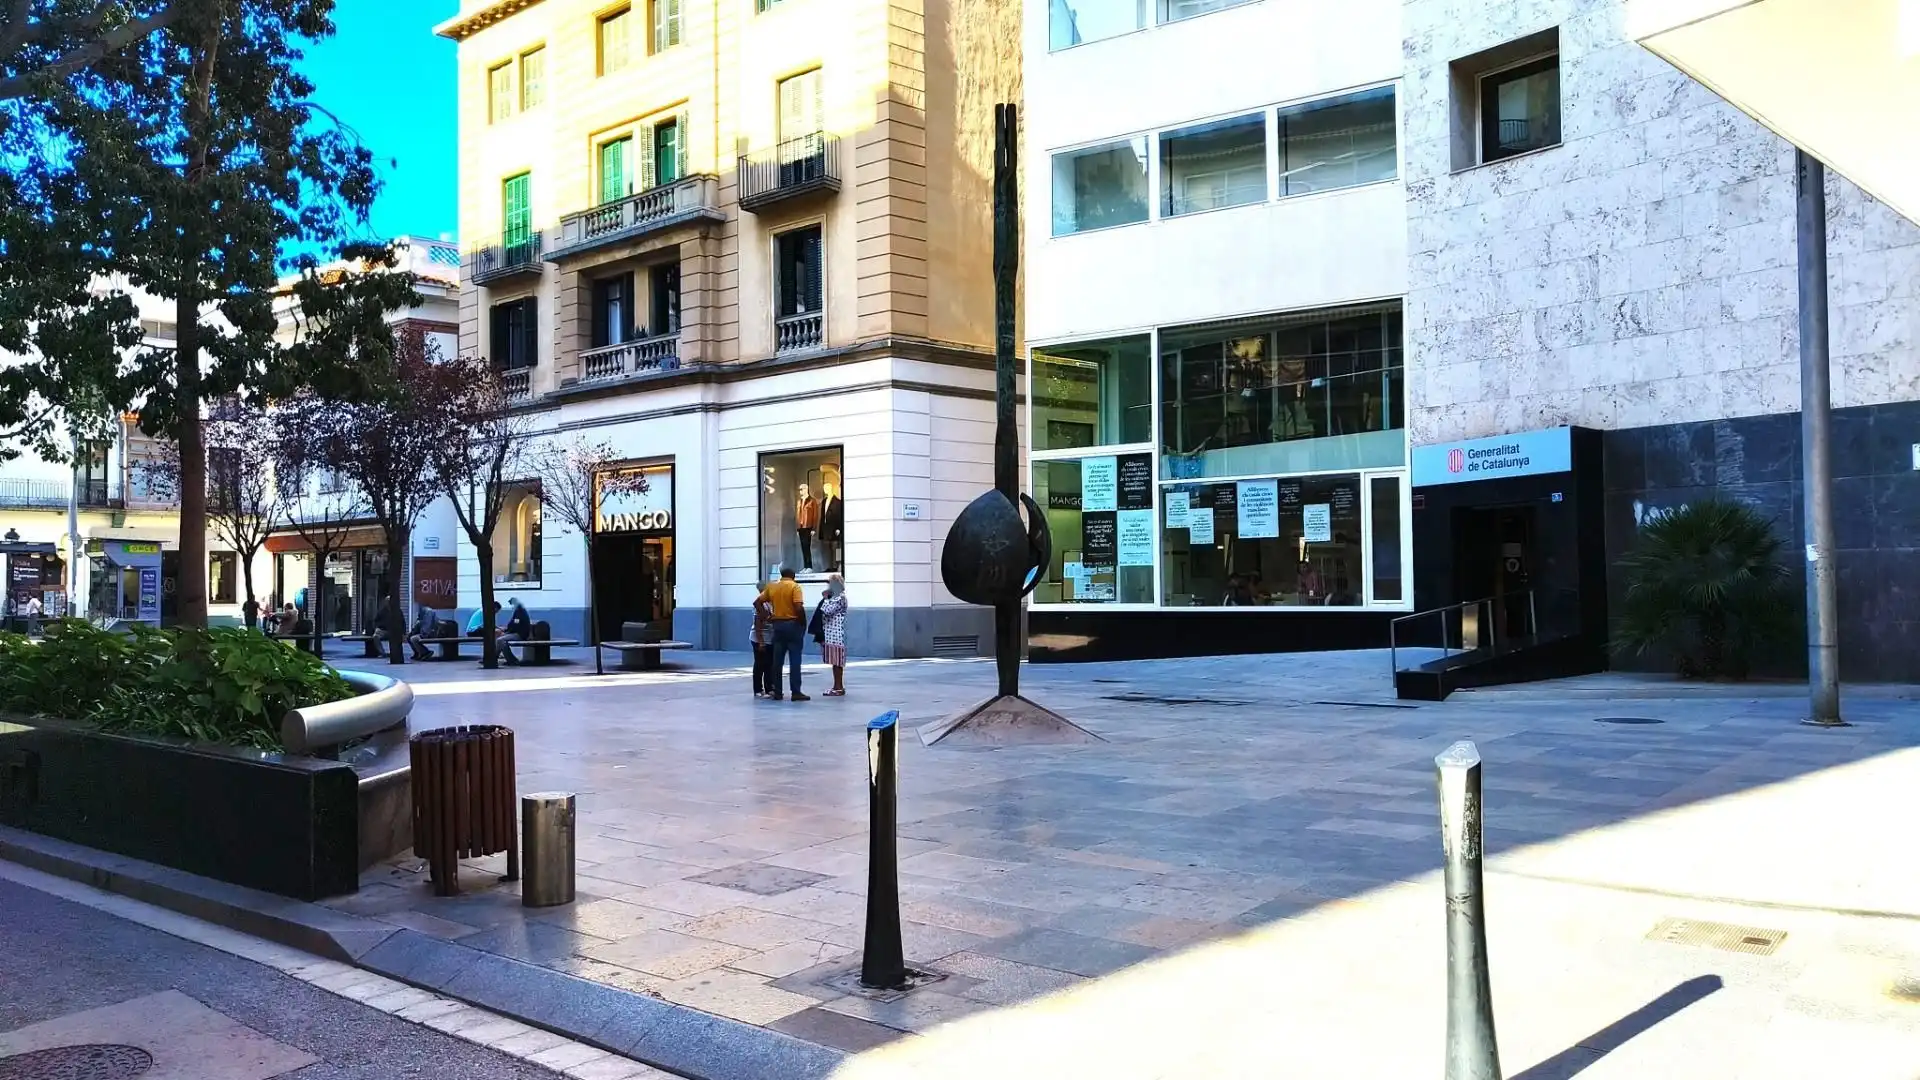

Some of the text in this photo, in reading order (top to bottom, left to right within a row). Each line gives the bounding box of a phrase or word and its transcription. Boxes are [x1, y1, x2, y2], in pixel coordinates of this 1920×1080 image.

[1467, 443, 1520, 459] Generalitat
[1468, 456, 1530, 472] de Catalunya
[600, 510, 669, 532] MANGO
[131, 544, 155, 552] ONCE
